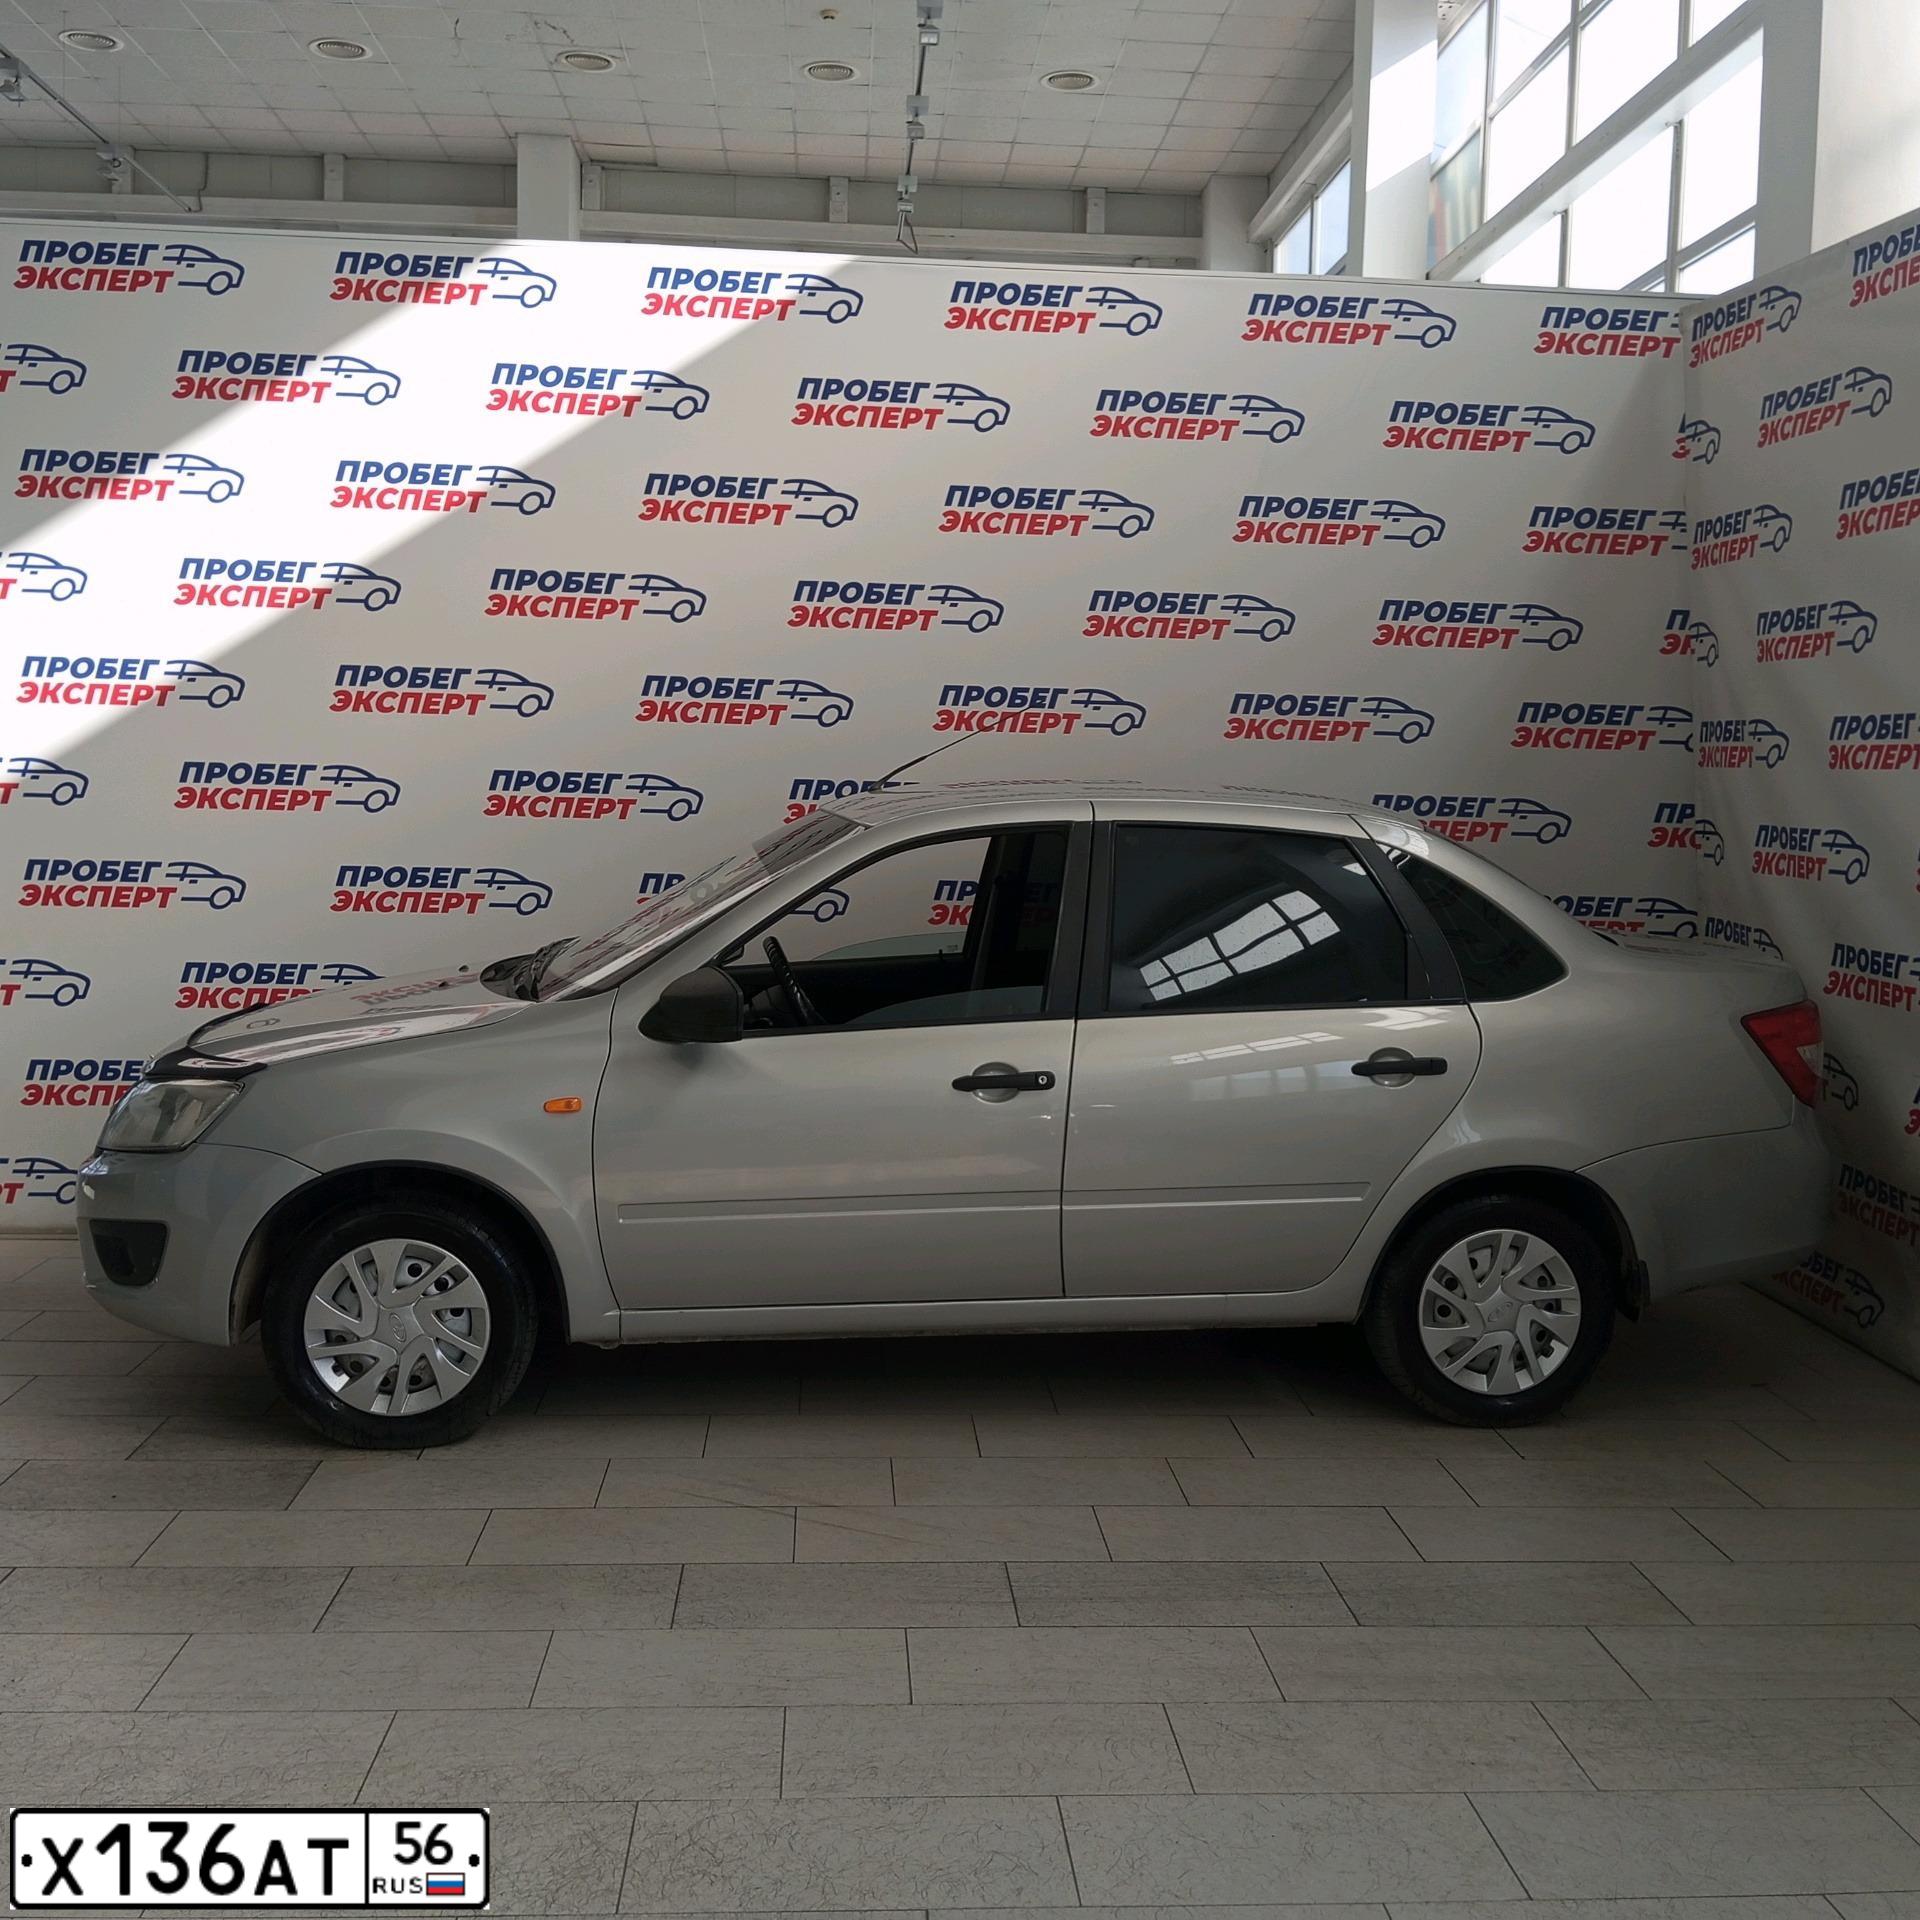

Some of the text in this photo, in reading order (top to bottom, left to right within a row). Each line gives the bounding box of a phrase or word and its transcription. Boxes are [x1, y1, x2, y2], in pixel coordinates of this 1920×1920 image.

[19, 239, 160, 267] ПРОБЕГ
[335, 251, 474, 279] ПРОБЕГ
[14, 265, 175, 293] ЭКСПЕРТ
[329, 277, 488, 306] ЭКСПЕРТ
[647, 266, 782, 294] ПРОБЕГ
[641, 292, 797, 321] ЭКСПЕРТ
[950, 280, 1083, 308] ПРОБЕГ
[1248, 293, 1379, 320] ПРОБЕГ
[943, 306, 1097, 334] ЭКСПЕРТ
[1541, 306, 1670, 332] ПРОБЕГ
[1692, 294, 1756, 341] ПРОБЕГ
[1241, 318, 1392, 346] ЭКСПЕРТ
[1534, 331, 1681, 358] ЭКСПЕРТ
[1689, 318, 1764, 368] ЭКСПЕРТ
[178, 349, 317, 377] ПРОБЕГ
[491, 362, 627, 391] ПРОБЕГ
[171, 375, 332, 404] ЭКСПЕРТ
[486, 388, 643, 418] ЭКСПЕРТ
[798, 377, 930, 404] ПРОБЕГ
[1096, 389, 1227, 416] ПРОБЕГ
[1760, 373, 1842, 419] ПРОБЕГ
[791, 402, 945, 431] ЭКСПЕРТ
[1390, 400, 1520, 427] ПРОБЕГ
[1757, 400, 1851, 448] ЭКСПЕРТ
[1089, 414, 1241, 442] ЭКСПЕРТ
[1382, 425, 1532, 453] ЭКСПЕРТ
[20, 448, 160, 475] ПРОБЕГ
[335, 460, 473, 486] ПРОБЕГ
[14, 474, 175, 502] ЭКСПЕРТ
[330, 485, 488, 513] ЭКСПЕРТ
[645, 473, 778, 500] ПРОБЕГ
[945, 485, 1074, 510] ПРОБЕГ
[638, 498, 793, 526] ЭКСПЕРТ
[1239, 495, 1369, 521] ПРОБЕГ
[1530, 506, 1657, 531] ПРОБЕГ
[938, 509, 1090, 537] ЭКСПЕРТ
[1232, 519, 1382, 546] ЭКСПЕРТ
[1693, 509, 1752, 544] ПРОБЕГ
[1522, 530, 1669, 557] ЭКСПЕРТ
[1691, 534, 1759, 570] ЭКСПЕРТ
[179, 557, 317, 583] ПРОБЕГ
[491, 568, 625, 595] ПРОБЕГ
[174, 583, 333, 610] ЭКСПЕРТ
[794, 580, 926, 605] ПРОБЕГ
[1088, 590, 1218, 615] ПРОБЕГ
[484, 593, 641, 621] ЭКСПЕРТ
[787, 604, 939, 632] ЭКСПЕРТ
[1379, 599, 1507, 625] ПРОБЕГ
[1757, 604, 1828, 635] ПРОБЕГ
[1082, 614, 1232, 641] ЭКСПЕРТ
[1371, 623, 1520, 650] ЭКСПЕРТ
[1756, 631, 1835, 663] ЭКСПЕРТ
[21, 655, 161, 681] ПРОБЕГ
[336, 664, 472, 690] ПРОБЕГ
[16, 681, 176, 707] ЭКСПЕРТ
[642, 675, 774, 700] ПРОБЕГ
[939, 684, 1068, 709] ПРОБЕГ
[329, 689, 487, 716] ЭКСПЕРТ
[634, 699, 789, 726] ЭКСПЕРТ
[1231, 693, 1359, 717] ПРОБЕГ
[1518, 702, 1644, 726] ПРОБЕГ
[932, 708, 1082, 735] ЭКСПЕРТ
[1223, 717, 1371, 742] ЭКСПЕРТ
[1700, 719, 1747, 742] ПРОБЕГ
[1829, 712, 1916, 741] ПРОБЕГ
[1510, 725, 1657, 752] ЭКСПЕРТ
[1698, 745, 1754, 769] ЭКСПЕРТ
[179, 761, 317, 786] ПРОБЕГ
[490, 769, 624, 795] ПРОБЕГ
[174, 786, 333, 812] ЭКСПЕРТ
[483, 793, 638, 821] ЭКСПЕРТ
[1755, 825, 1822, 852] ПРОБЕГ
[24, 858, 162, 883] ПРОБЕГ
[335, 865, 472, 889] ПРОБЕГ
[1752, 851, 1828, 880] ЭКСПЕРТ
[18, 883, 178, 909] ЭКСПЕРТ
[329, 889, 486, 915] ЭКСПЕРТ
[1704, 917, 1752, 946] ПРОБЕГ
[180, 961, 318, 985] ПРОБЕГ
[1831, 943, 1909, 979] ПРОБЕГ
[1823, 971, 1917, 1012] ЭКСПЕРТ
[1839, 1164, 1908, 1211] ПРОБЕГ
